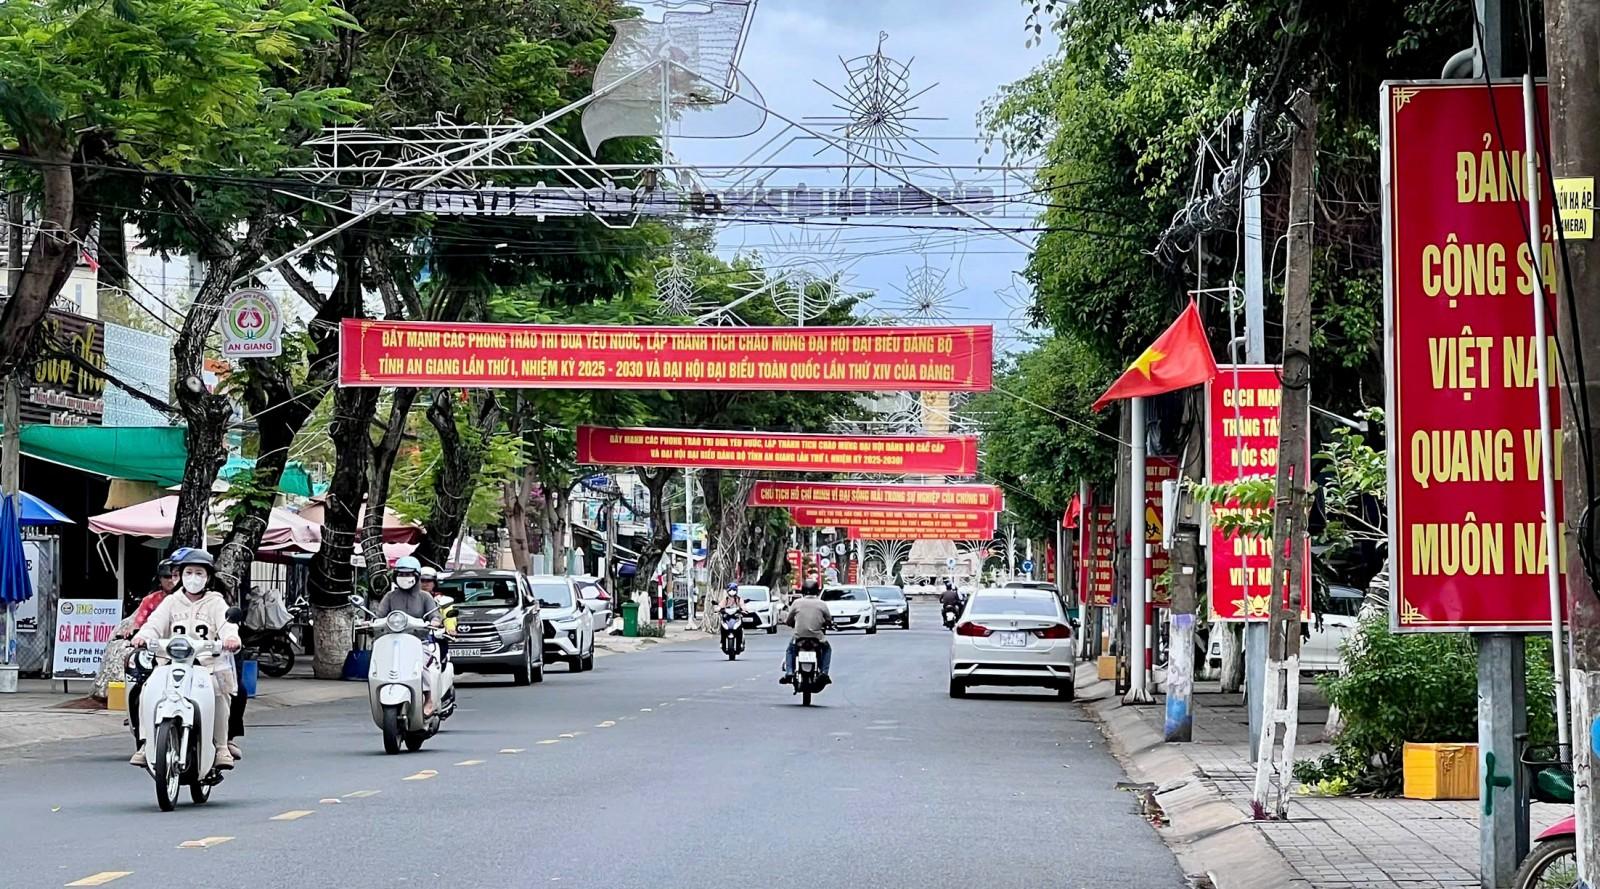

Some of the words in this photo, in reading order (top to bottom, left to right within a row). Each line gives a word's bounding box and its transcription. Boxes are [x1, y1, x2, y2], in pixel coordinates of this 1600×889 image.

[1456, 132, 1541, 202] ĐẢNG
[1561, 218, 1586, 234] MERA)
[1422, 232, 1506, 308] CỘNG
[1516, 224, 1557, 295] SẢ
[244, 342, 272, 350] GIANG
[406, 331, 440, 351] MẠNH
[443, 330, 465, 348] CÁC
[468, 332, 506, 348] PHONG
[510, 330, 537, 349] TRÀO
[541, 332, 558, 349] THI
[561, 333, 582, 349] ĐUA
[586, 332, 606, 350] YÊU
[646, 332, 668, 353] LẬP
[670, 333, 708, 350] THÀNH
[711, 332, 736, 351] TÍCH
[738, 333, 768, 351] CHÀO
[808, 335, 828, 355] ĐẠI
[830, 332, 850, 356] HỘI
[852, 336, 872, 356] ĐẠI
[903, 332, 934, 353] ĐẢNG
[937, 335, 953, 356] BỘ
[378, 353, 404, 375] TỈNH
[406, 358, 422, 375] AN
[426, 358, 460, 376] GIANG
[487, 356, 510, 376] THỨ
[521, 356, 558, 380] NHIỆM
[560, 357, 576, 377] KỲ
[578, 361, 606, 377] 2025
[616, 361, 644, 378] 2030
[646, 358, 660, 378] VÀ
[663, 361, 682, 381] ĐẠI
[685, 359, 704, 381] HỘI
[706, 362, 726, 382] ĐẠI
[758, 360, 788, 378] TOÀN
[790, 358, 820, 380] QUỐC
[848, 361, 871, 380] THỨ
[872, 363, 892, 380] XIV
[894, 358, 916, 380] CỦA
[1428, 325, 1493, 401] VIỆT
[1257, 388, 1282, 410] MẠN
[1262, 416, 1280, 437] TÁ
[1260, 448, 1278, 467] SO
[1411, 429, 1514, 488] QUANG
[1412, 512, 1504, 576] MUÔN
[1514, 511, 1568, 575] NĂ
[59, 620, 71, 642] CÀ
[74, 620, 91, 642] PHÊ
